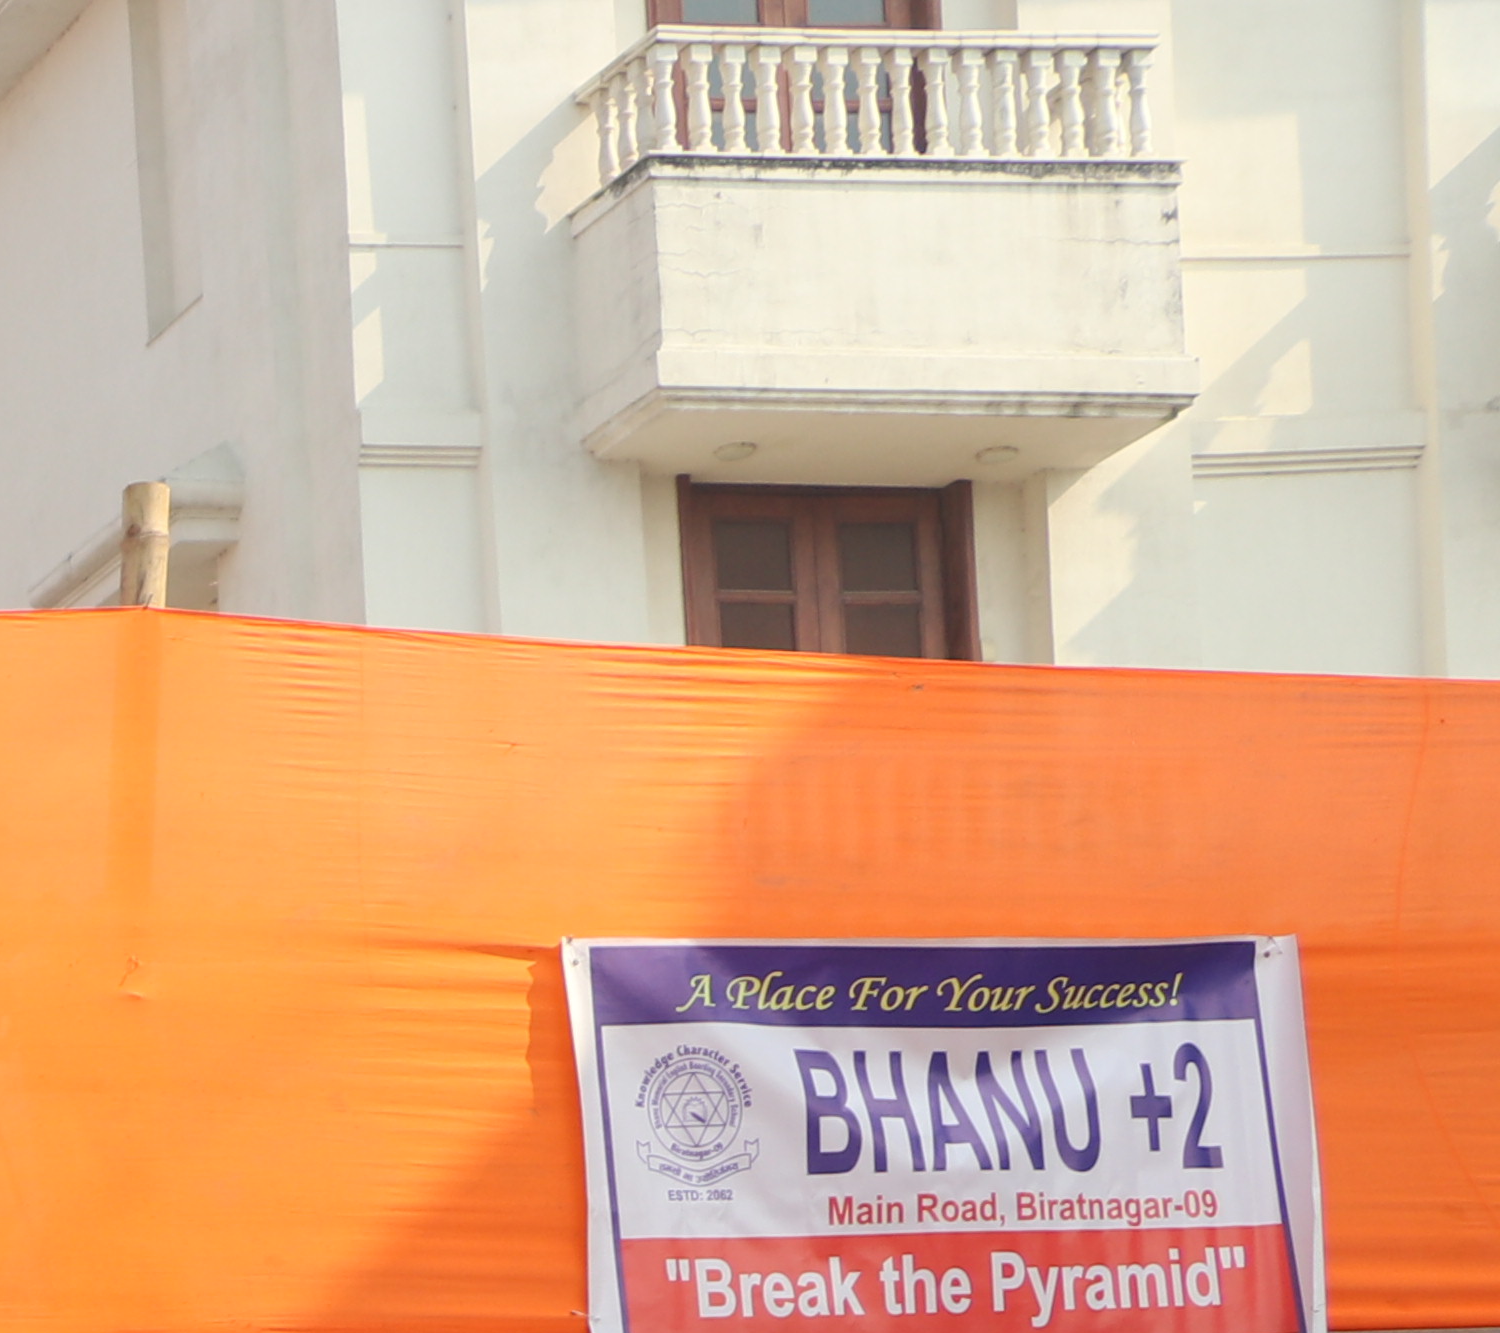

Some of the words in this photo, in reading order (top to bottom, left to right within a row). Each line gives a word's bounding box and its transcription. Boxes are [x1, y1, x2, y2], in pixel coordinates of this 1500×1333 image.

[676, 975, 715, 1011] A
[726, 972, 837, 1010] Place
[849, 977, 928, 1010] For
[937, 974, 1035, 1011] Your
[1035, 973, 1182, 1013] Success!
[635, 1053, 674, 1108] Knowledge
[676, 1045, 730, 1066] Character
[730, 1064, 752, 1107] Service
[795, 1049, 1101, 1175] BHANU
[1130, 1043, 1223, 1168] +2
[668, 1190, 703, 1202] ESTD:
[707, 1189, 733, 1201] 2062
[829, 1195, 903, 1224] Main
[918, 1193, 1004, 1224] Road,
[1016, 1190, 1217, 1226] Biratnagar-09
[666, 1257, 864, 1317] "Break
[880, 1255, 971, 1315] the
[991, 1246, 1244, 1327] Pyramid"
